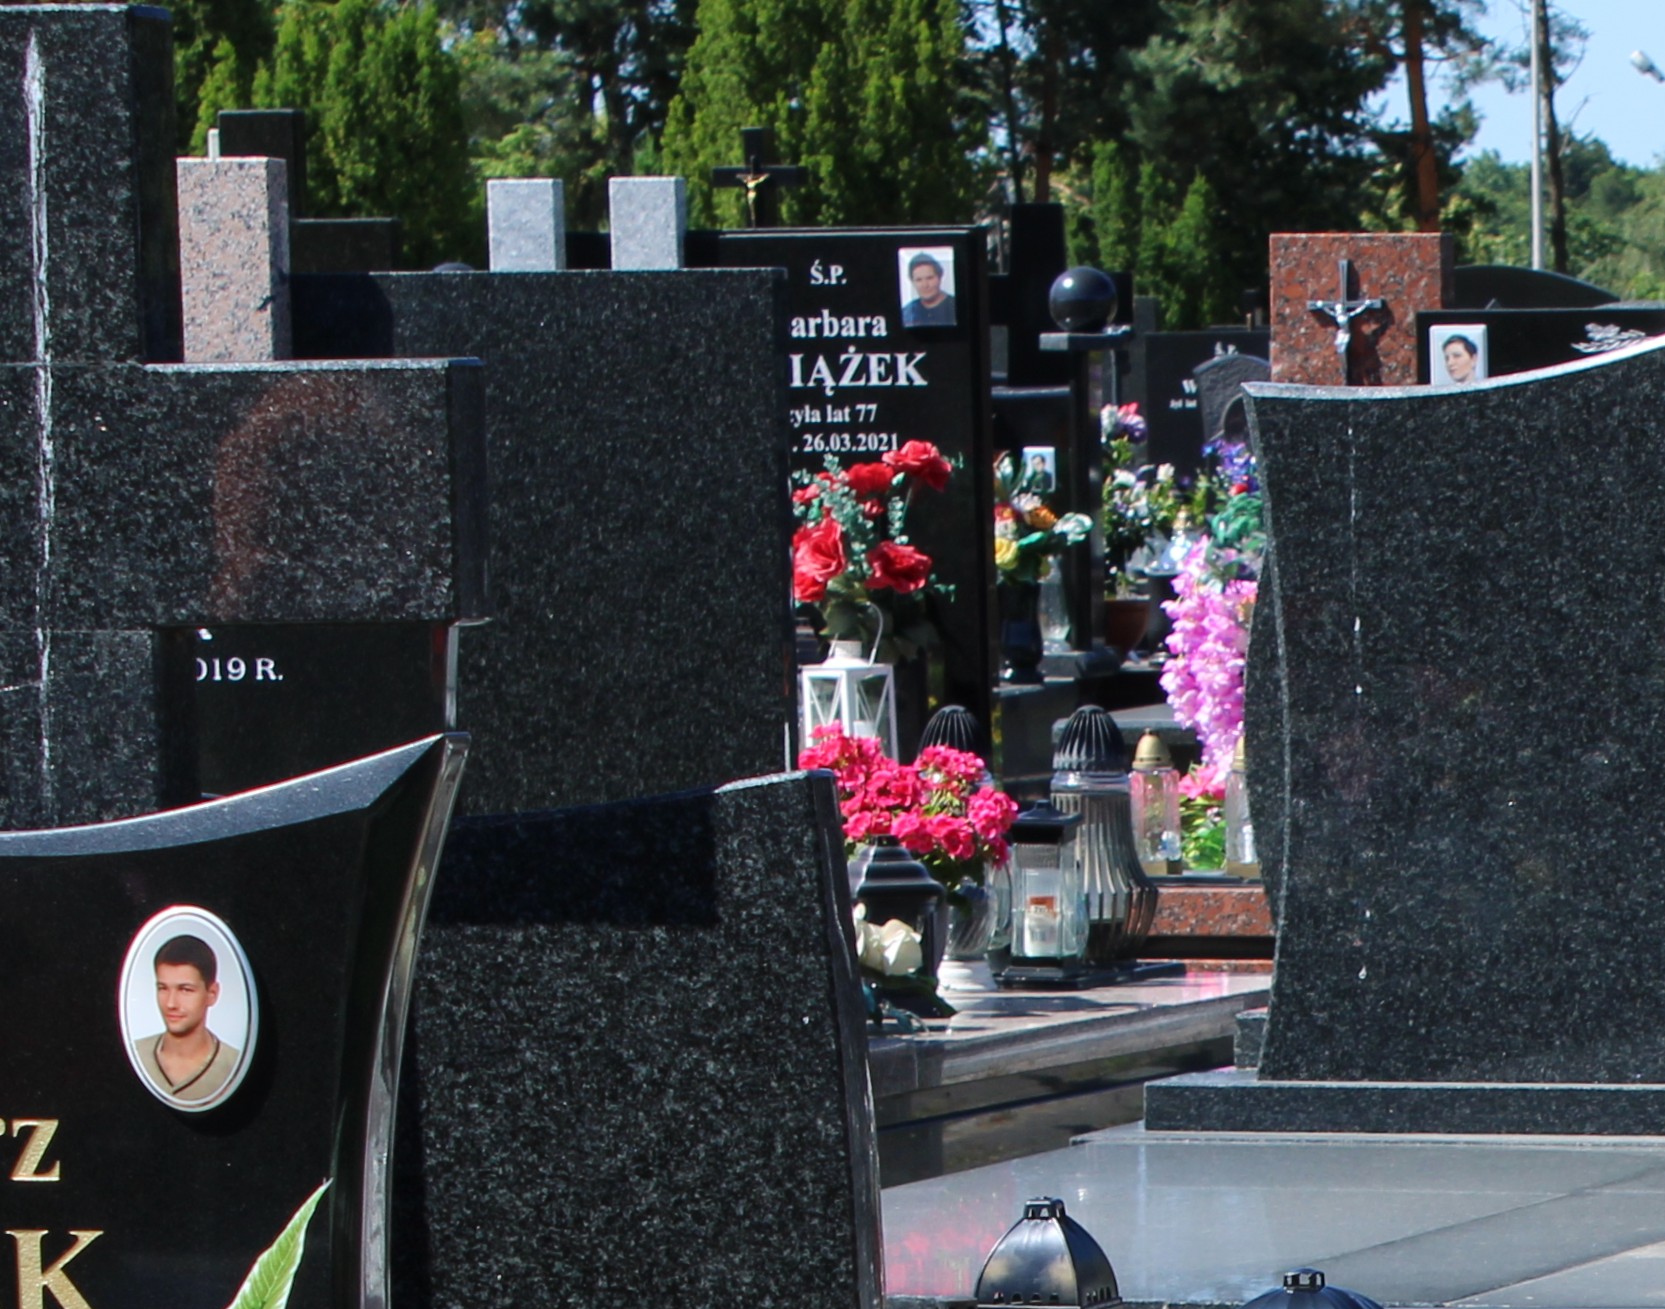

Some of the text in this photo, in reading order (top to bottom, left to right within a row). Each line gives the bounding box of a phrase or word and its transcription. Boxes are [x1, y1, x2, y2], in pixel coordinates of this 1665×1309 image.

[810, 258, 847, 285] Ś.P.
[790, 309, 888, 338] arbara
[789, 345, 928, 396] IĄŻEK
[826, 404, 851, 423] lat
[855, 403, 878, 423] 77
[802, 432, 899, 452] 26.03.2021
[255, 657, 284, 681] R.
